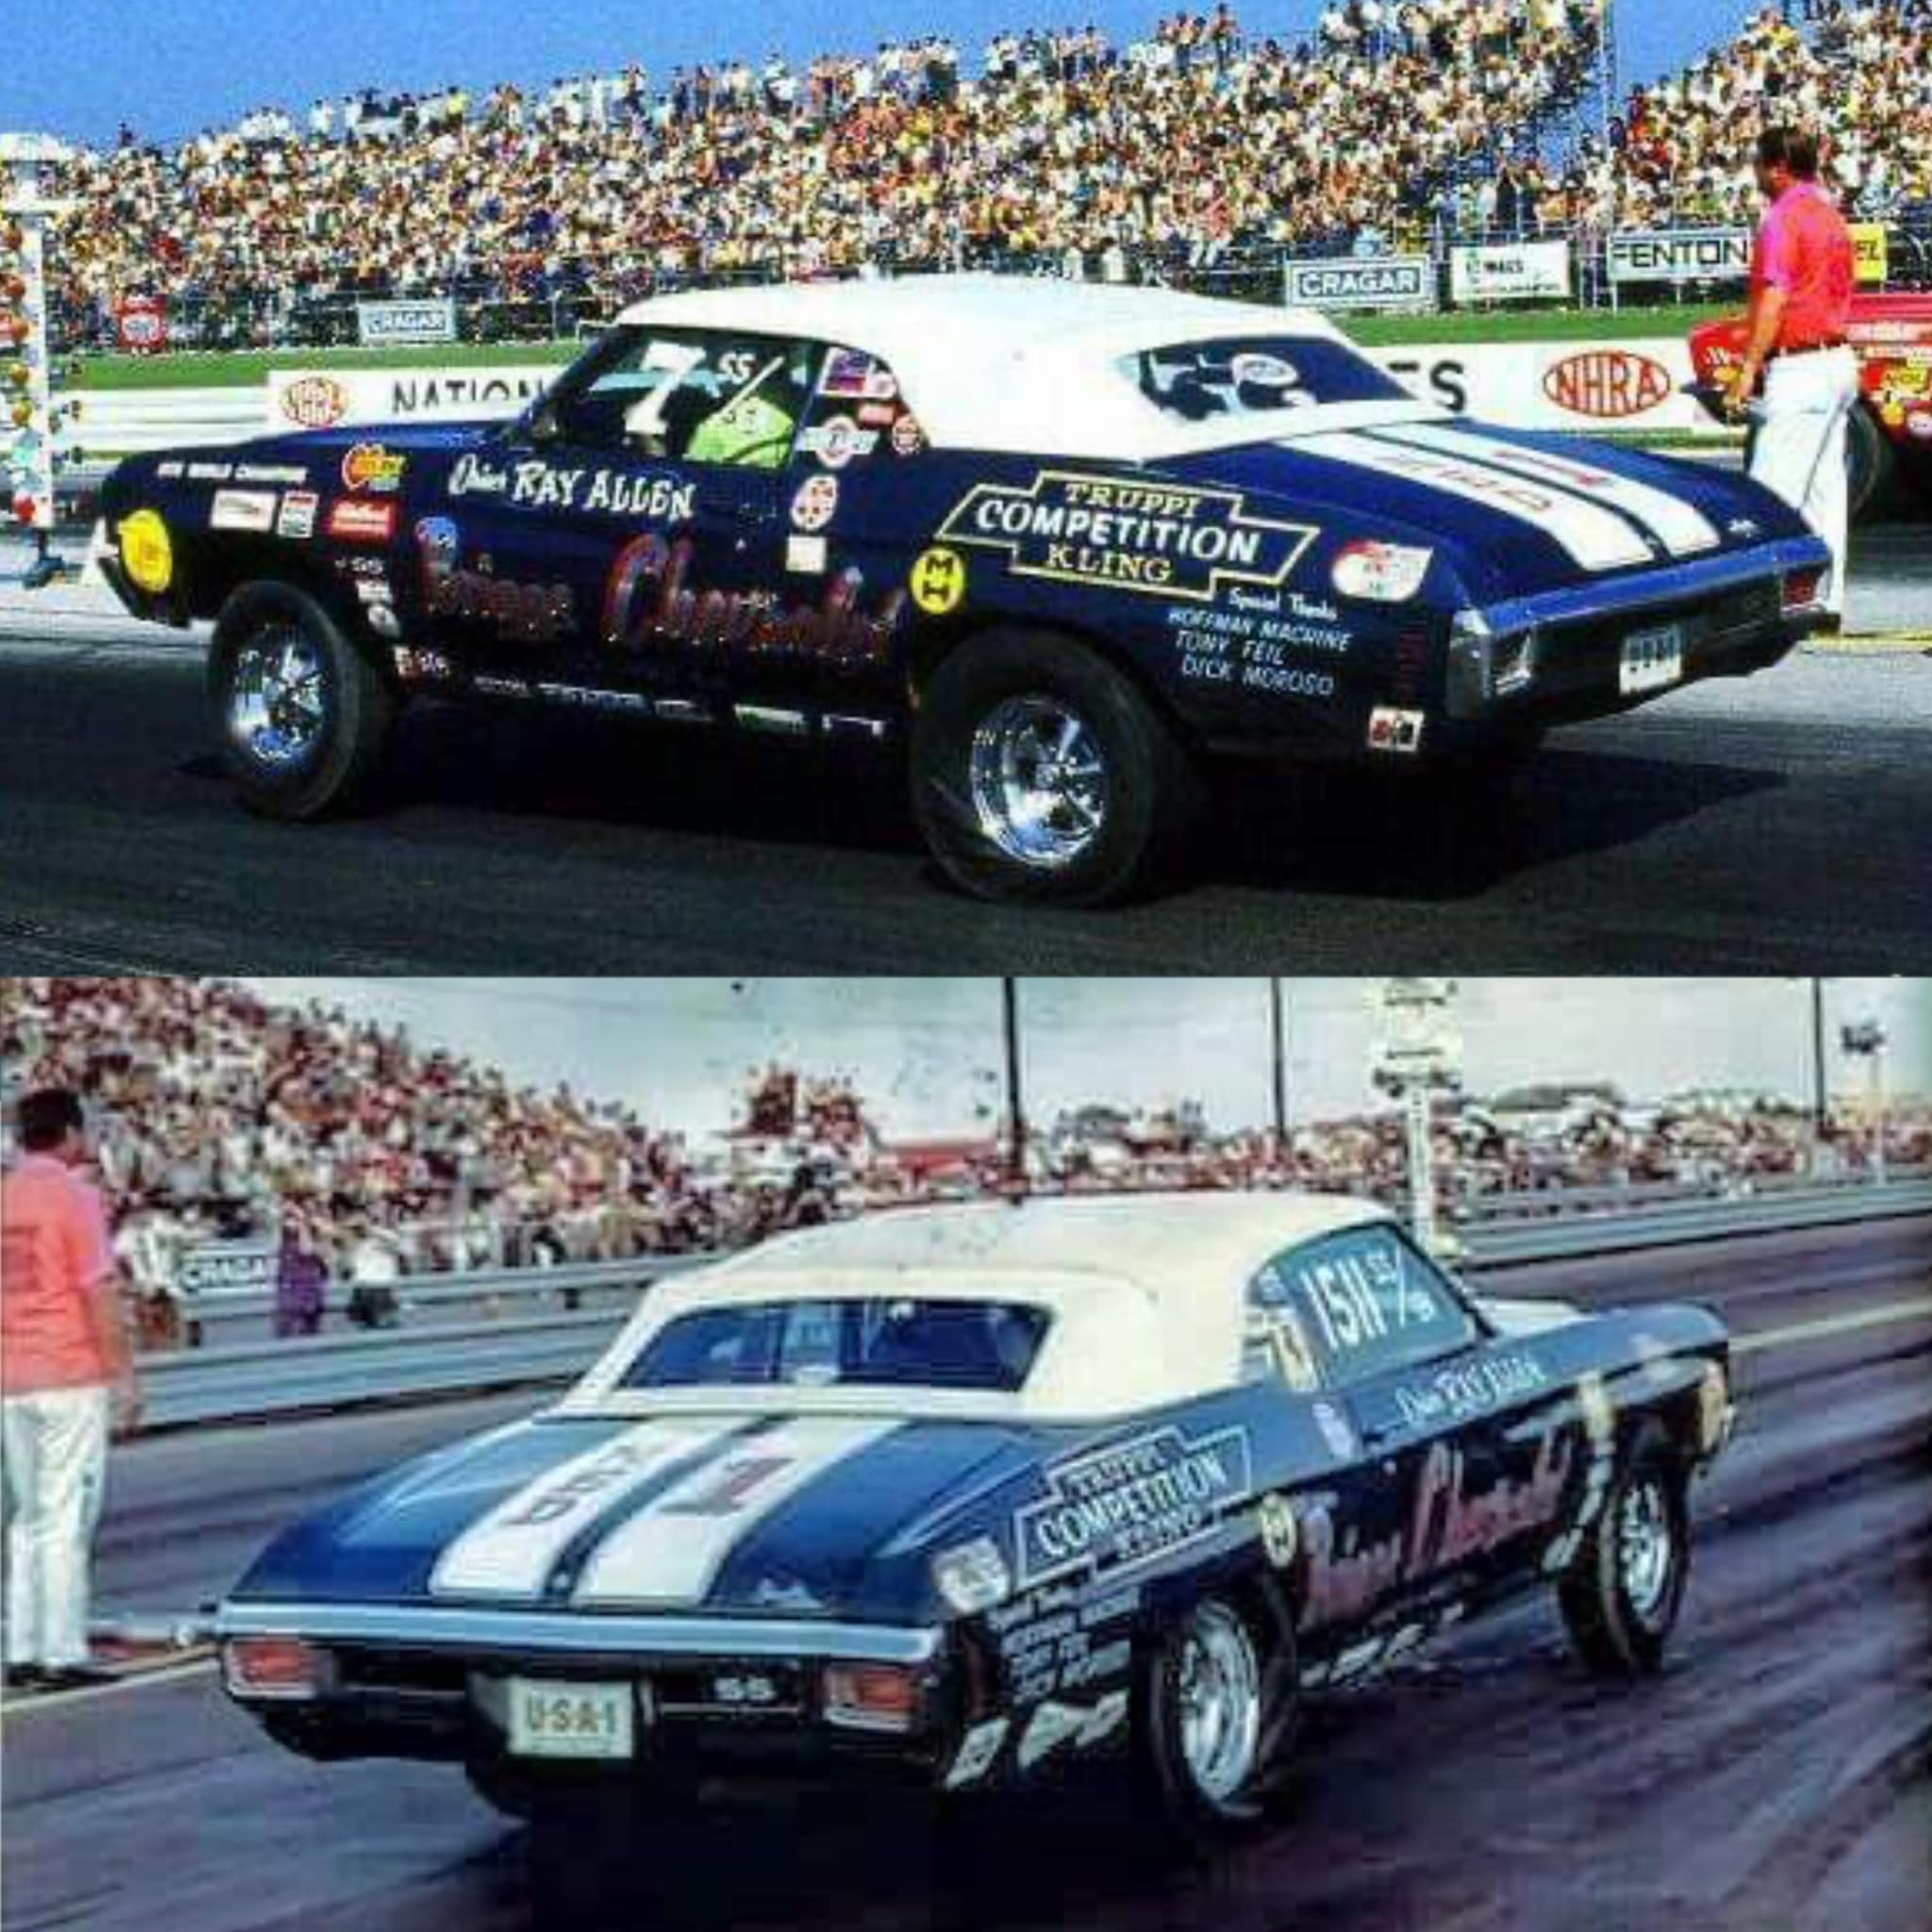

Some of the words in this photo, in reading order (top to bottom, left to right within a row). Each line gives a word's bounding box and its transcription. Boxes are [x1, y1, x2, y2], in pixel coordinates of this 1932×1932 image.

[1611, 240, 1748, 269] FENTON
[1301, 267, 1417, 297] CRAGAR
[1557, 352, 1658, 413] NHRA
[511, 460, 586, 505] RAY
[582, 470, 697, 521] ALLEN
[1065, 482, 1201, 519] TRUPPI
[976, 498, 1262, 564] COMPETITION
[1046, 542, 1172, 584] KLING
[1175, 630, 1230, 654] TONY
[1241, 640, 1285, 665] FEIL
[1259, 620, 1354, 653] MACHINE
[1181, 654, 1233, 681] DICK
[1241, 666, 1335, 696] MOROSO
